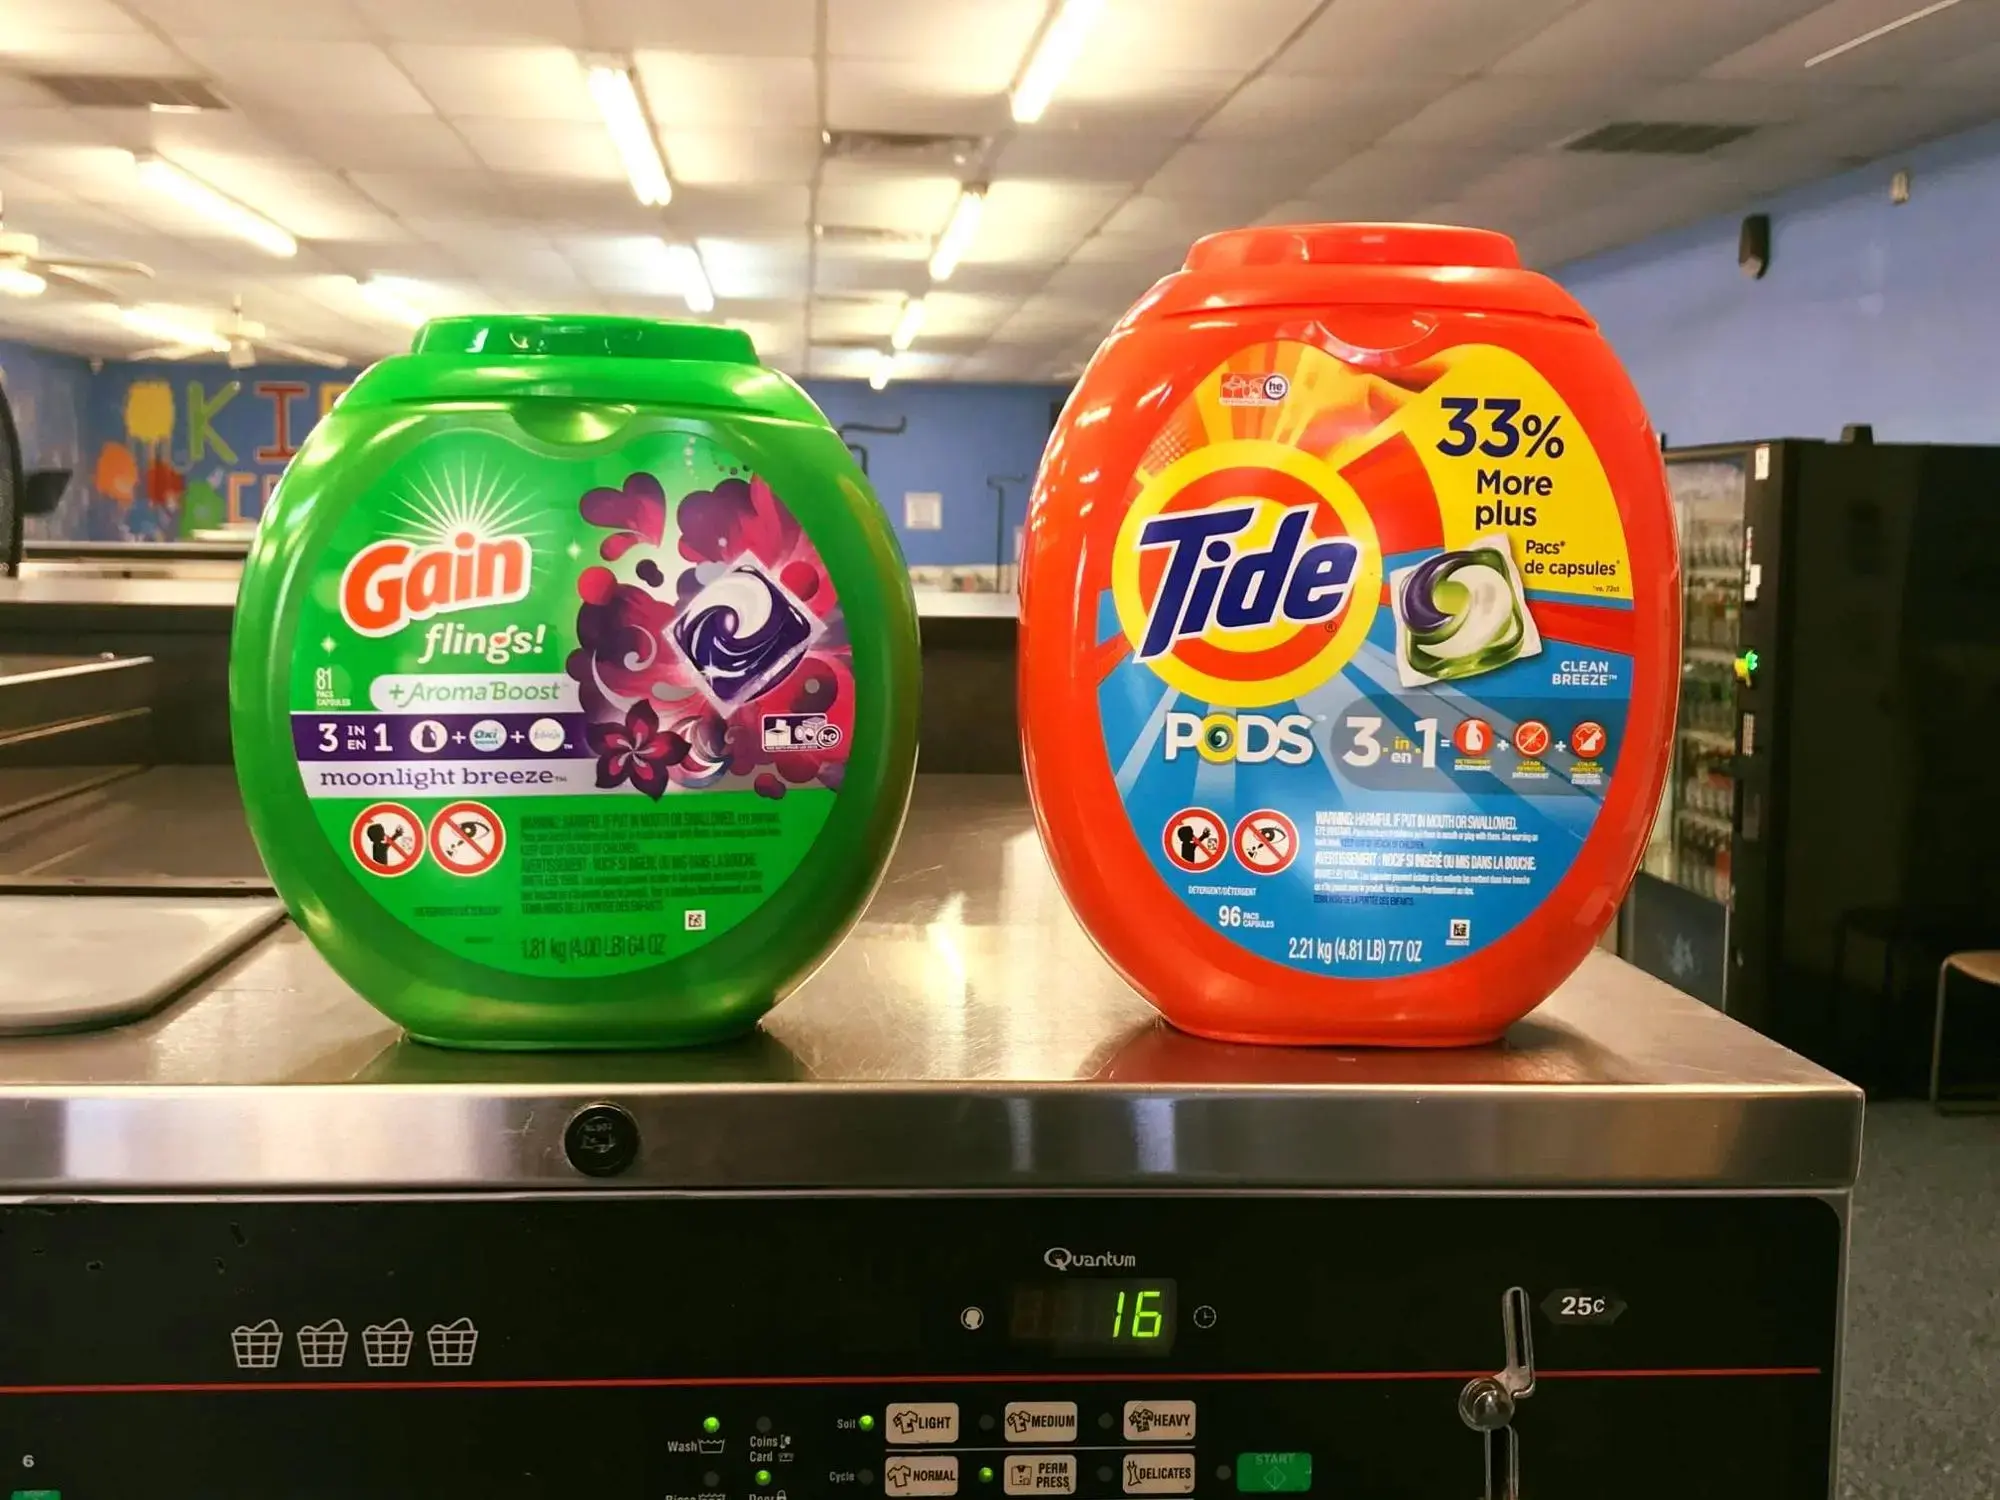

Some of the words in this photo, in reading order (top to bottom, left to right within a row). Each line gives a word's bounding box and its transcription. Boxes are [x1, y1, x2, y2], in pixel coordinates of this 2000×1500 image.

[1436, 397, 1564, 459] 33%
[1476, 469, 1553, 496] More
[1475, 500, 1538, 530] plus
[1524, 560, 1545, 575] de
[341, 531, 531, 636] Gain
[1136, 504, 1361, 661] Tide
[417, 624, 546, 664] flings!
[1560, 660, 1609, 673] CLEAN
[316, 667, 332, 690] 81
[318, 722, 339, 752] 3
[347, 725, 366, 736] IN
[374, 722, 393, 752] 1
[1164, 711, 1314, 764] PODS
[1342, 716, 1383, 767] 3
[1414, 718, 1438, 768] 1
[347, 740, 366, 750] EN
[1391, 753, 1411, 764] en
[320, 767, 461, 790] moonlight
[1426, 814, 1455, 829] MOUTH
[1219, 905, 1241, 927] 96
[1288, 937, 1314, 960] 2.21
[1317, 939, 1332, 964] kg
[1334, 938, 1363, 962] (4.81
[1366, 939, 1386, 964] LB)
[1389, 940, 1404, 962] 77
[1406, 940, 1422, 962] OZ
[1044, 1247, 1136, 1271] Quantum
[1112, 1290, 1162, 1337] 16
[836, 1418, 856, 1430] Soil
[918, 1416, 951, 1429] LIGHT
[1031, 1415, 1075, 1428] MEDIUM
[1154, 1413, 1191, 1427] HEAVY
[667, 1440, 698, 1453] Wash
[750, 1435, 778, 1448] Coins
[22, 1454, 35, 1468] 6
[750, 1451, 773, 1462] Card
[913, 1469, 956, 1482] NORMAL
[1038, 1462, 1068, 1475] PERM
[1139, 1467, 1192, 1480] DELICATES
[829, 1470, 855, 1483] Cycle
[1036, 1476, 1069, 1488] PRESS
